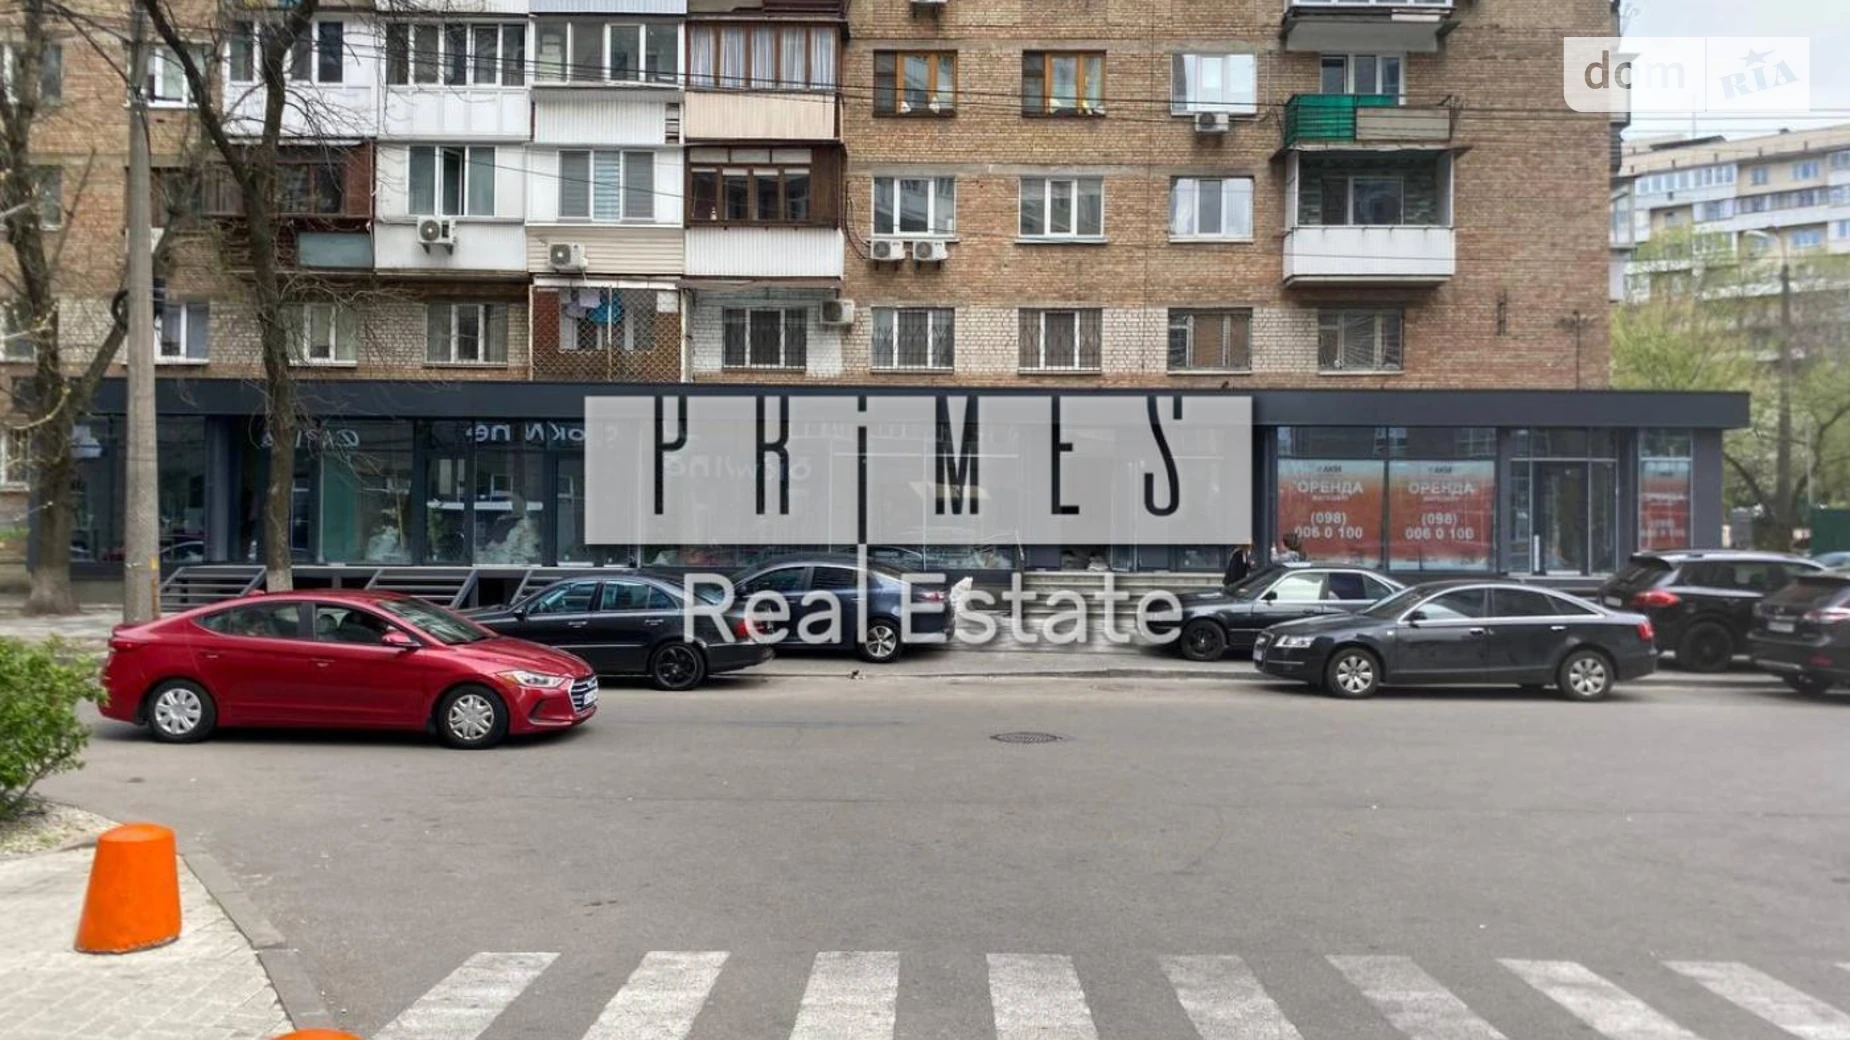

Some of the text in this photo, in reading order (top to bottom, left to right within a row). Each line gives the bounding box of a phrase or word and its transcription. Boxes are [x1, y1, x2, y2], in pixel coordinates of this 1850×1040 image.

[1297, 481, 1364, 495] ОРЕНДА
[1408, 482, 1474, 496] ОРЕНДА
[1311, 512, 1347, 525] (098)
[1422, 513, 1457, 526] (098)
